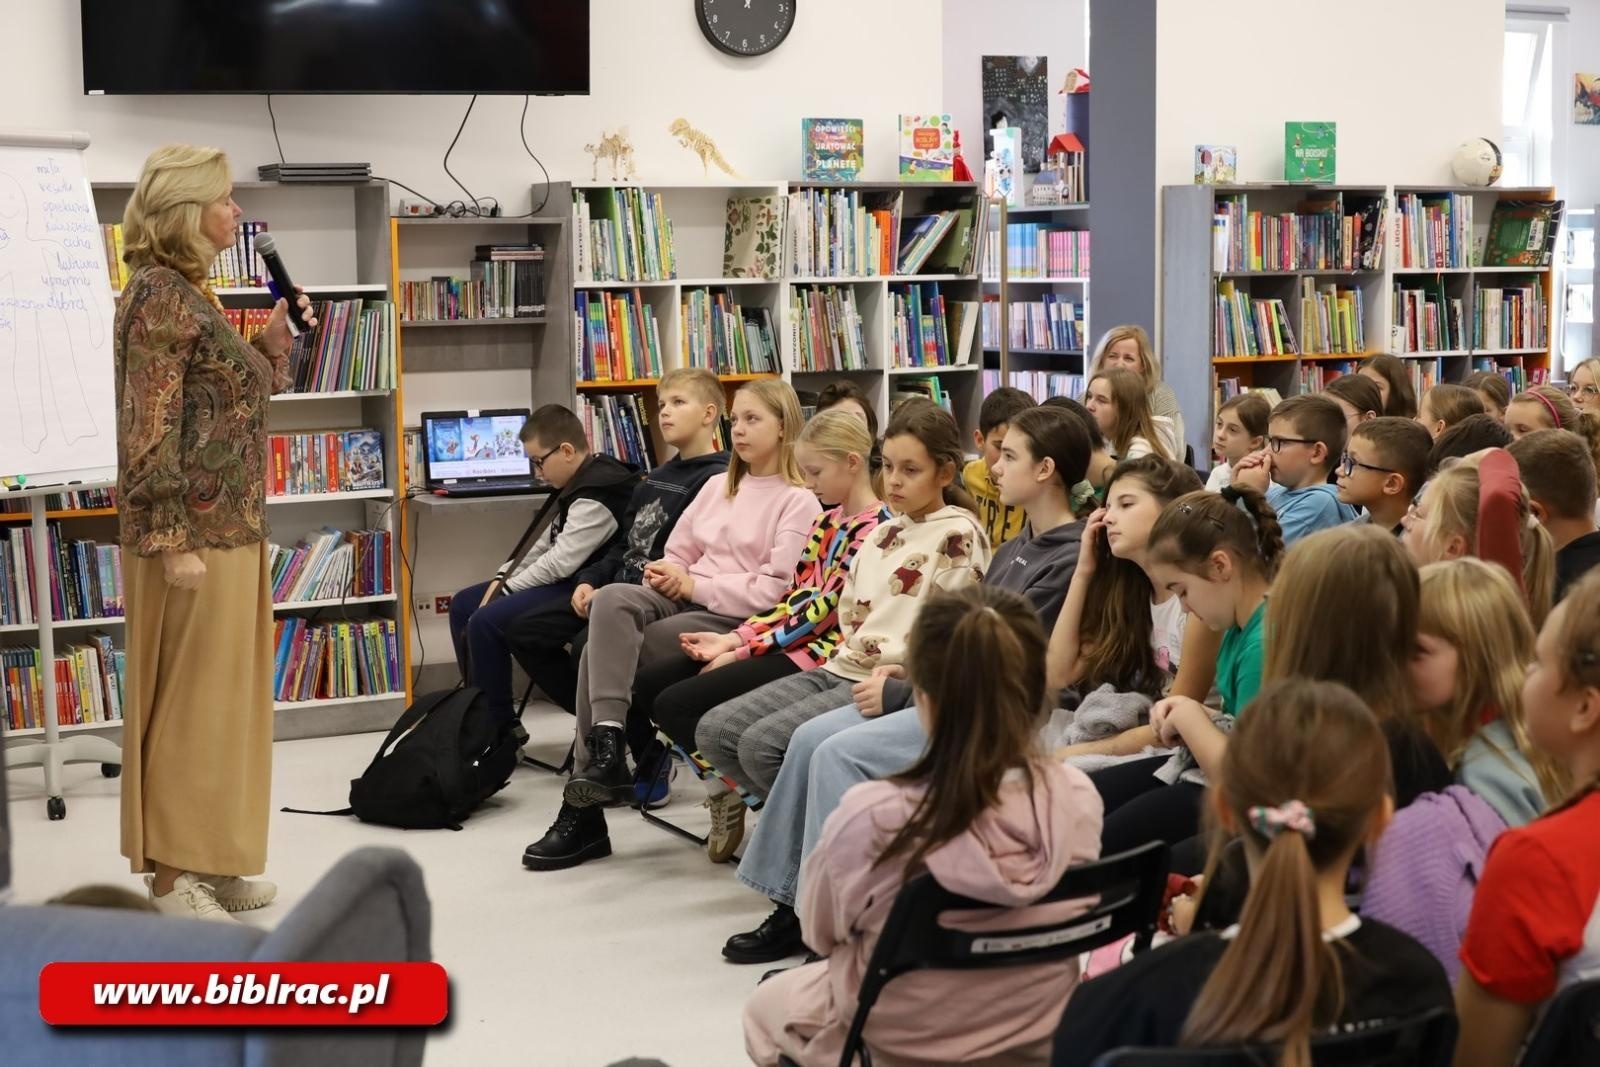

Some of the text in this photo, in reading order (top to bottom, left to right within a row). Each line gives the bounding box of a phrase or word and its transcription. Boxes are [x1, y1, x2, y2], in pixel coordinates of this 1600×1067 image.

[778, 3, 784, 12] 3
[712, 14, 718, 23] 8
[725, 31, 731, 39] 7
[760, 34, 766, 43] 5
[742, 39, 748, 48] 6
